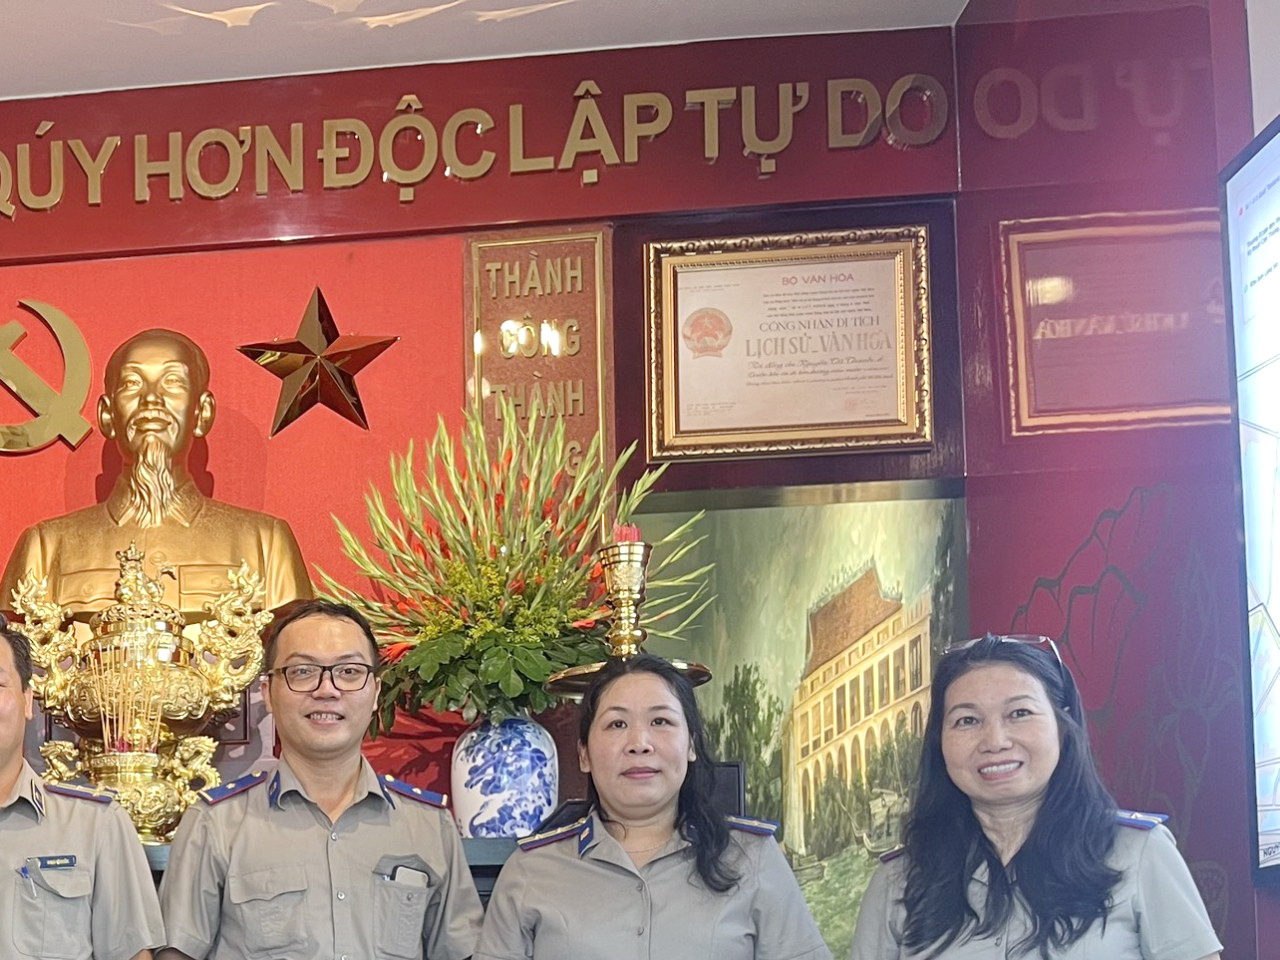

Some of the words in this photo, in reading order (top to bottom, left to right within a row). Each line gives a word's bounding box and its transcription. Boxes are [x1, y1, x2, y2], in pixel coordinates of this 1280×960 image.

[133, 122, 304, 203] HƠN
[317, 94, 496, 203] ĐỘC
[509, 80, 673, 184] LẬP
[685, 82, 809, 177] TỰ
[827, 73, 949, 149] DO
[485, 250, 584, 298] THÀNH
[500, 313, 581, 359] CÔNG
[745, 337, 785, 358] LỊCH
[490, 370, 585, 421] THÀNH
